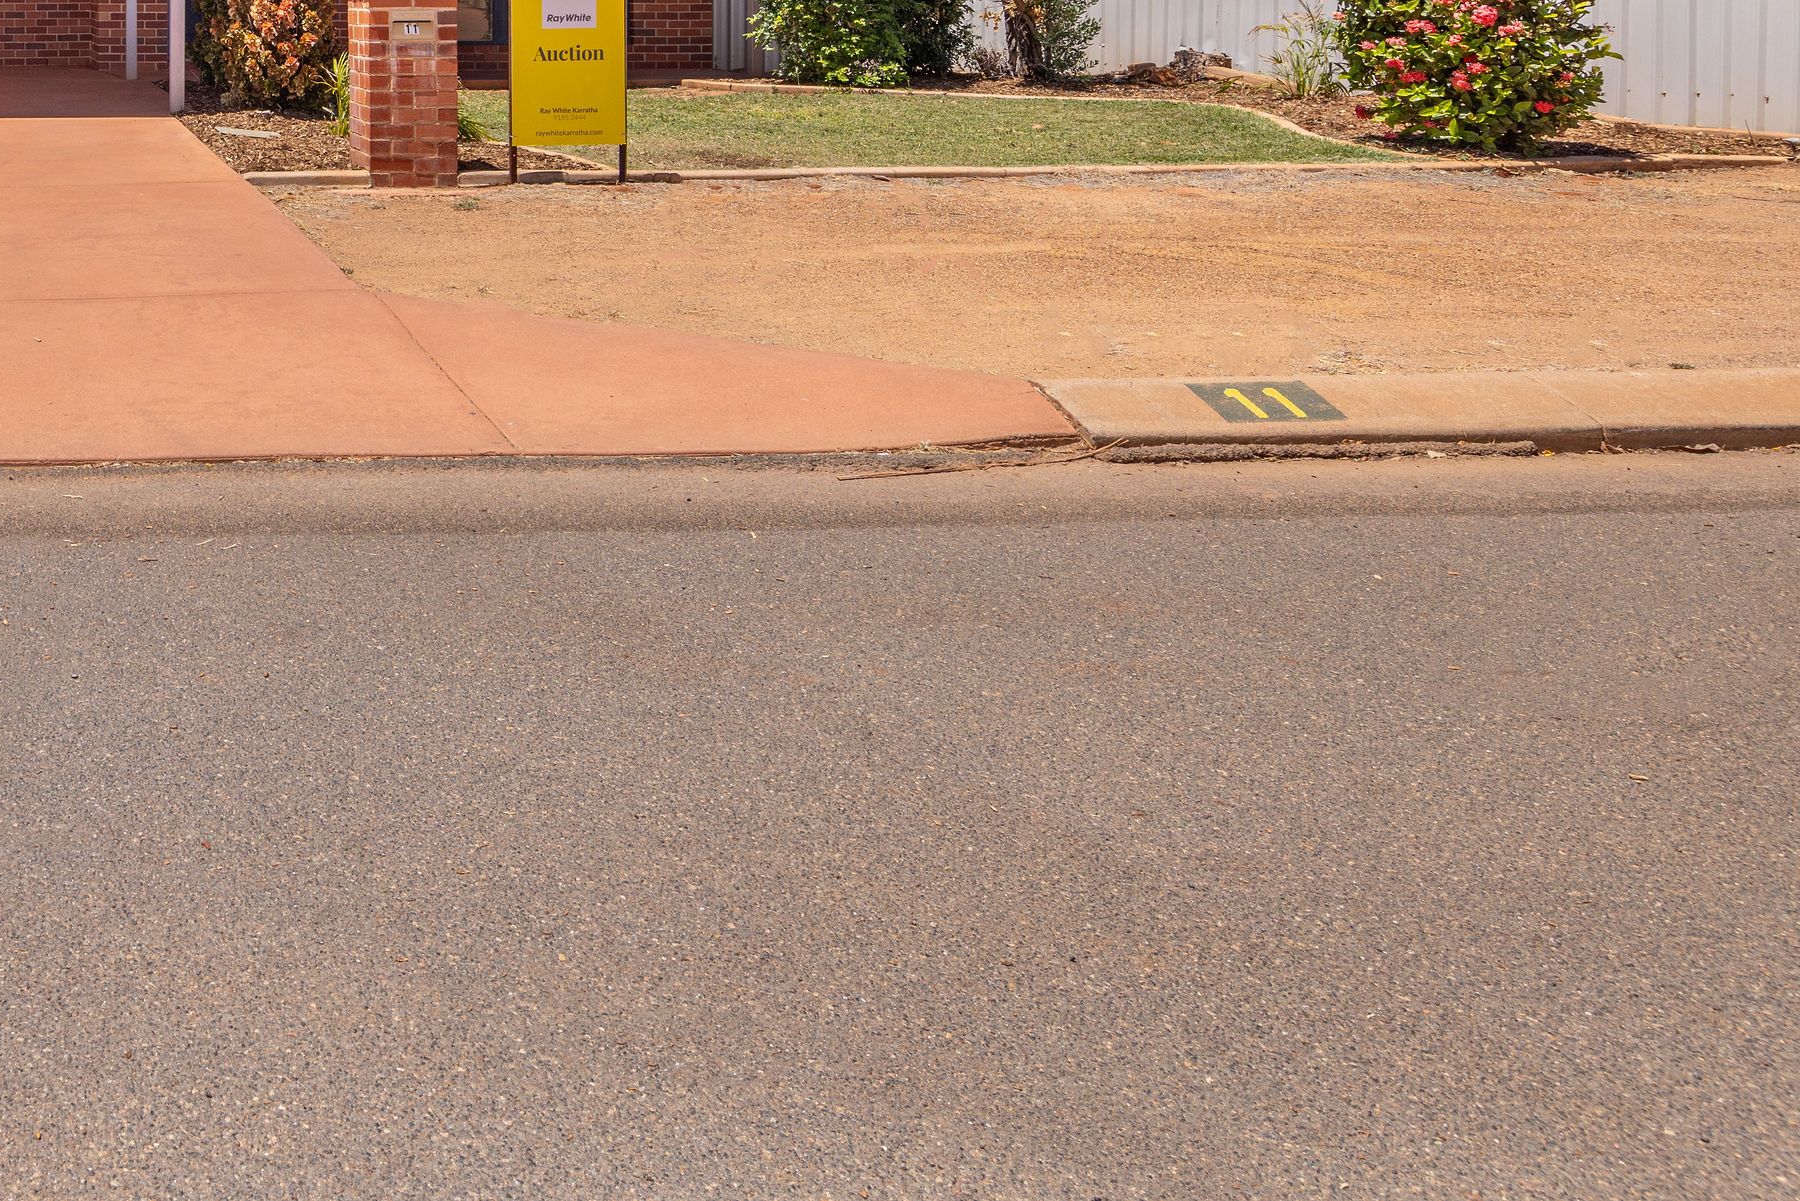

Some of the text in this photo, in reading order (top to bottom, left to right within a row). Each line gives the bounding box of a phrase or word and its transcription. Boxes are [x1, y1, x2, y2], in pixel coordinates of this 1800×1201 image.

[405, 24, 418, 34] 11
[533, 44, 605, 62] Auction
[535, 129, 603, 137] raywhitekarratha.com
[1224, 387, 1308, 419] 11
